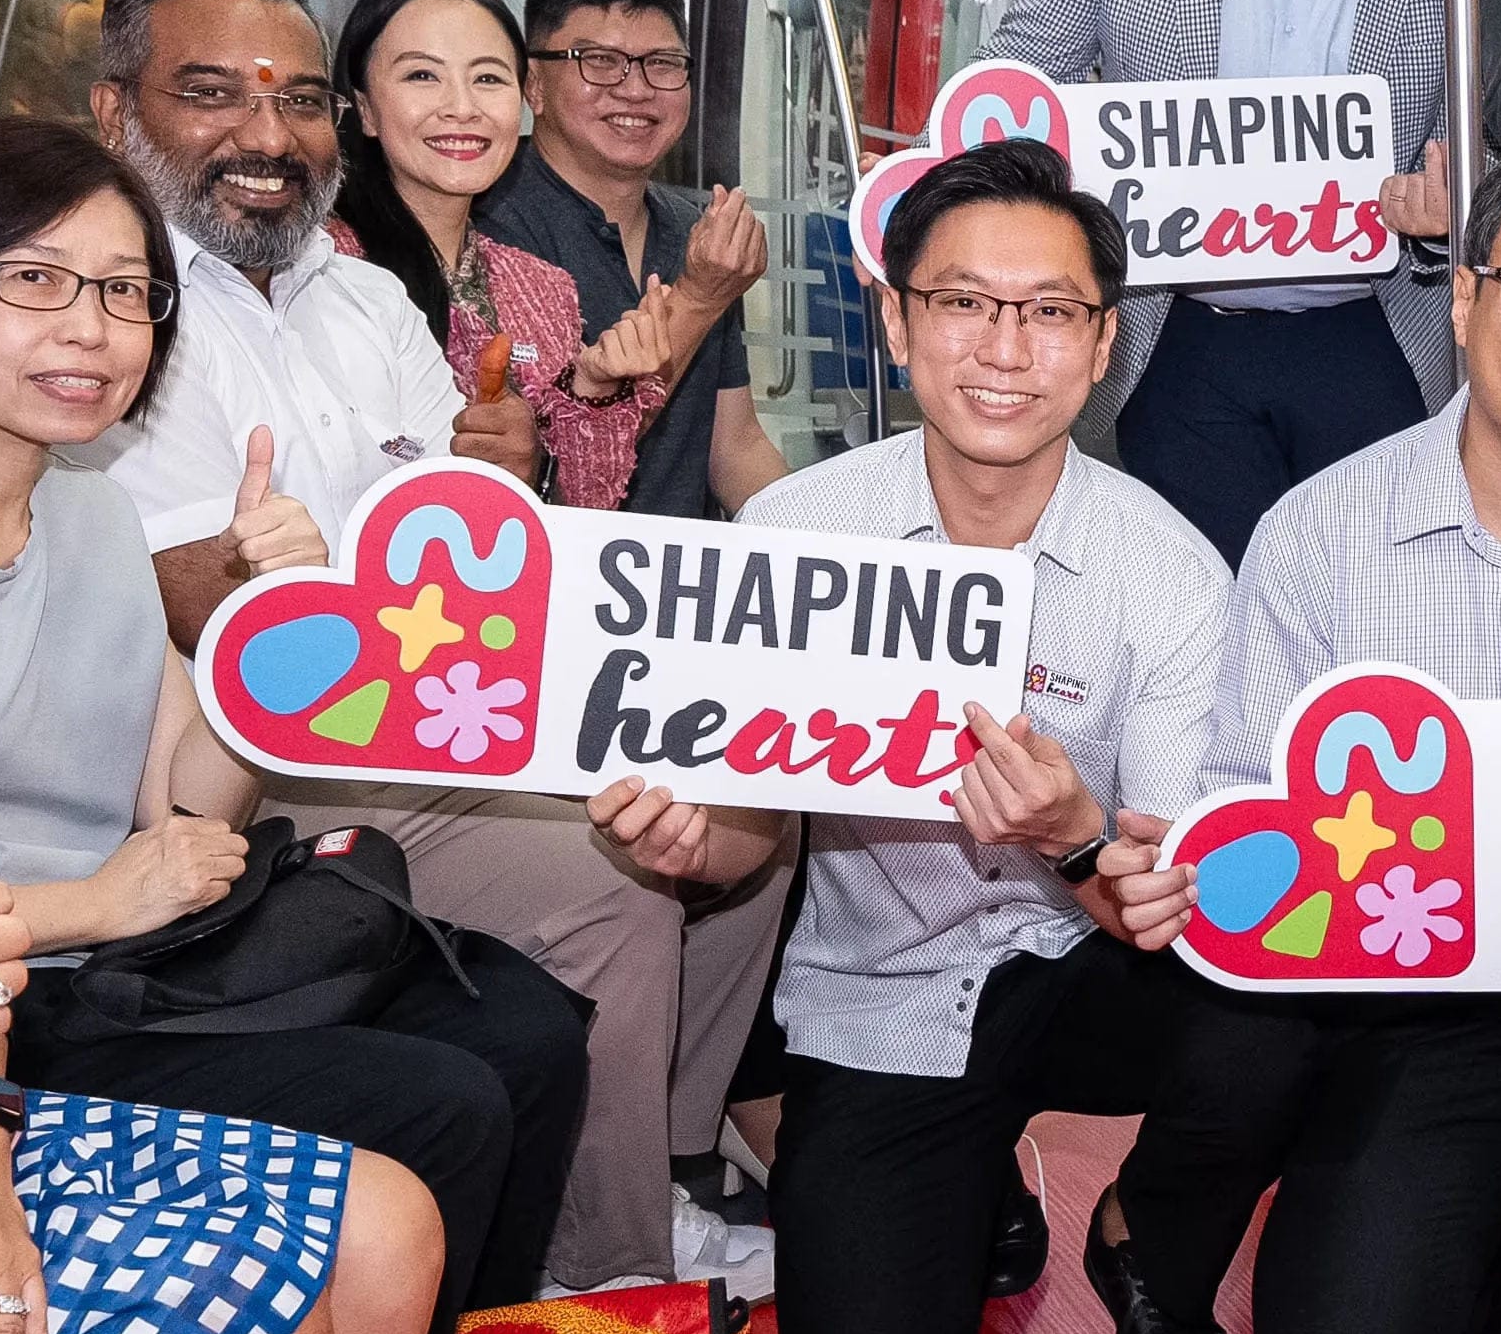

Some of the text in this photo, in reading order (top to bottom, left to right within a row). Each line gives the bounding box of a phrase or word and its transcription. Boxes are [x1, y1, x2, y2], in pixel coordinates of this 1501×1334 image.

[1098, 92, 1375, 170] SHAPING
[1109, 178, 1388, 263] hearts
[594, 538, 1005, 668] SHAPING
[1047, 682, 1085, 703] hearts
[1050, 672, 1087, 691] SHAPING
